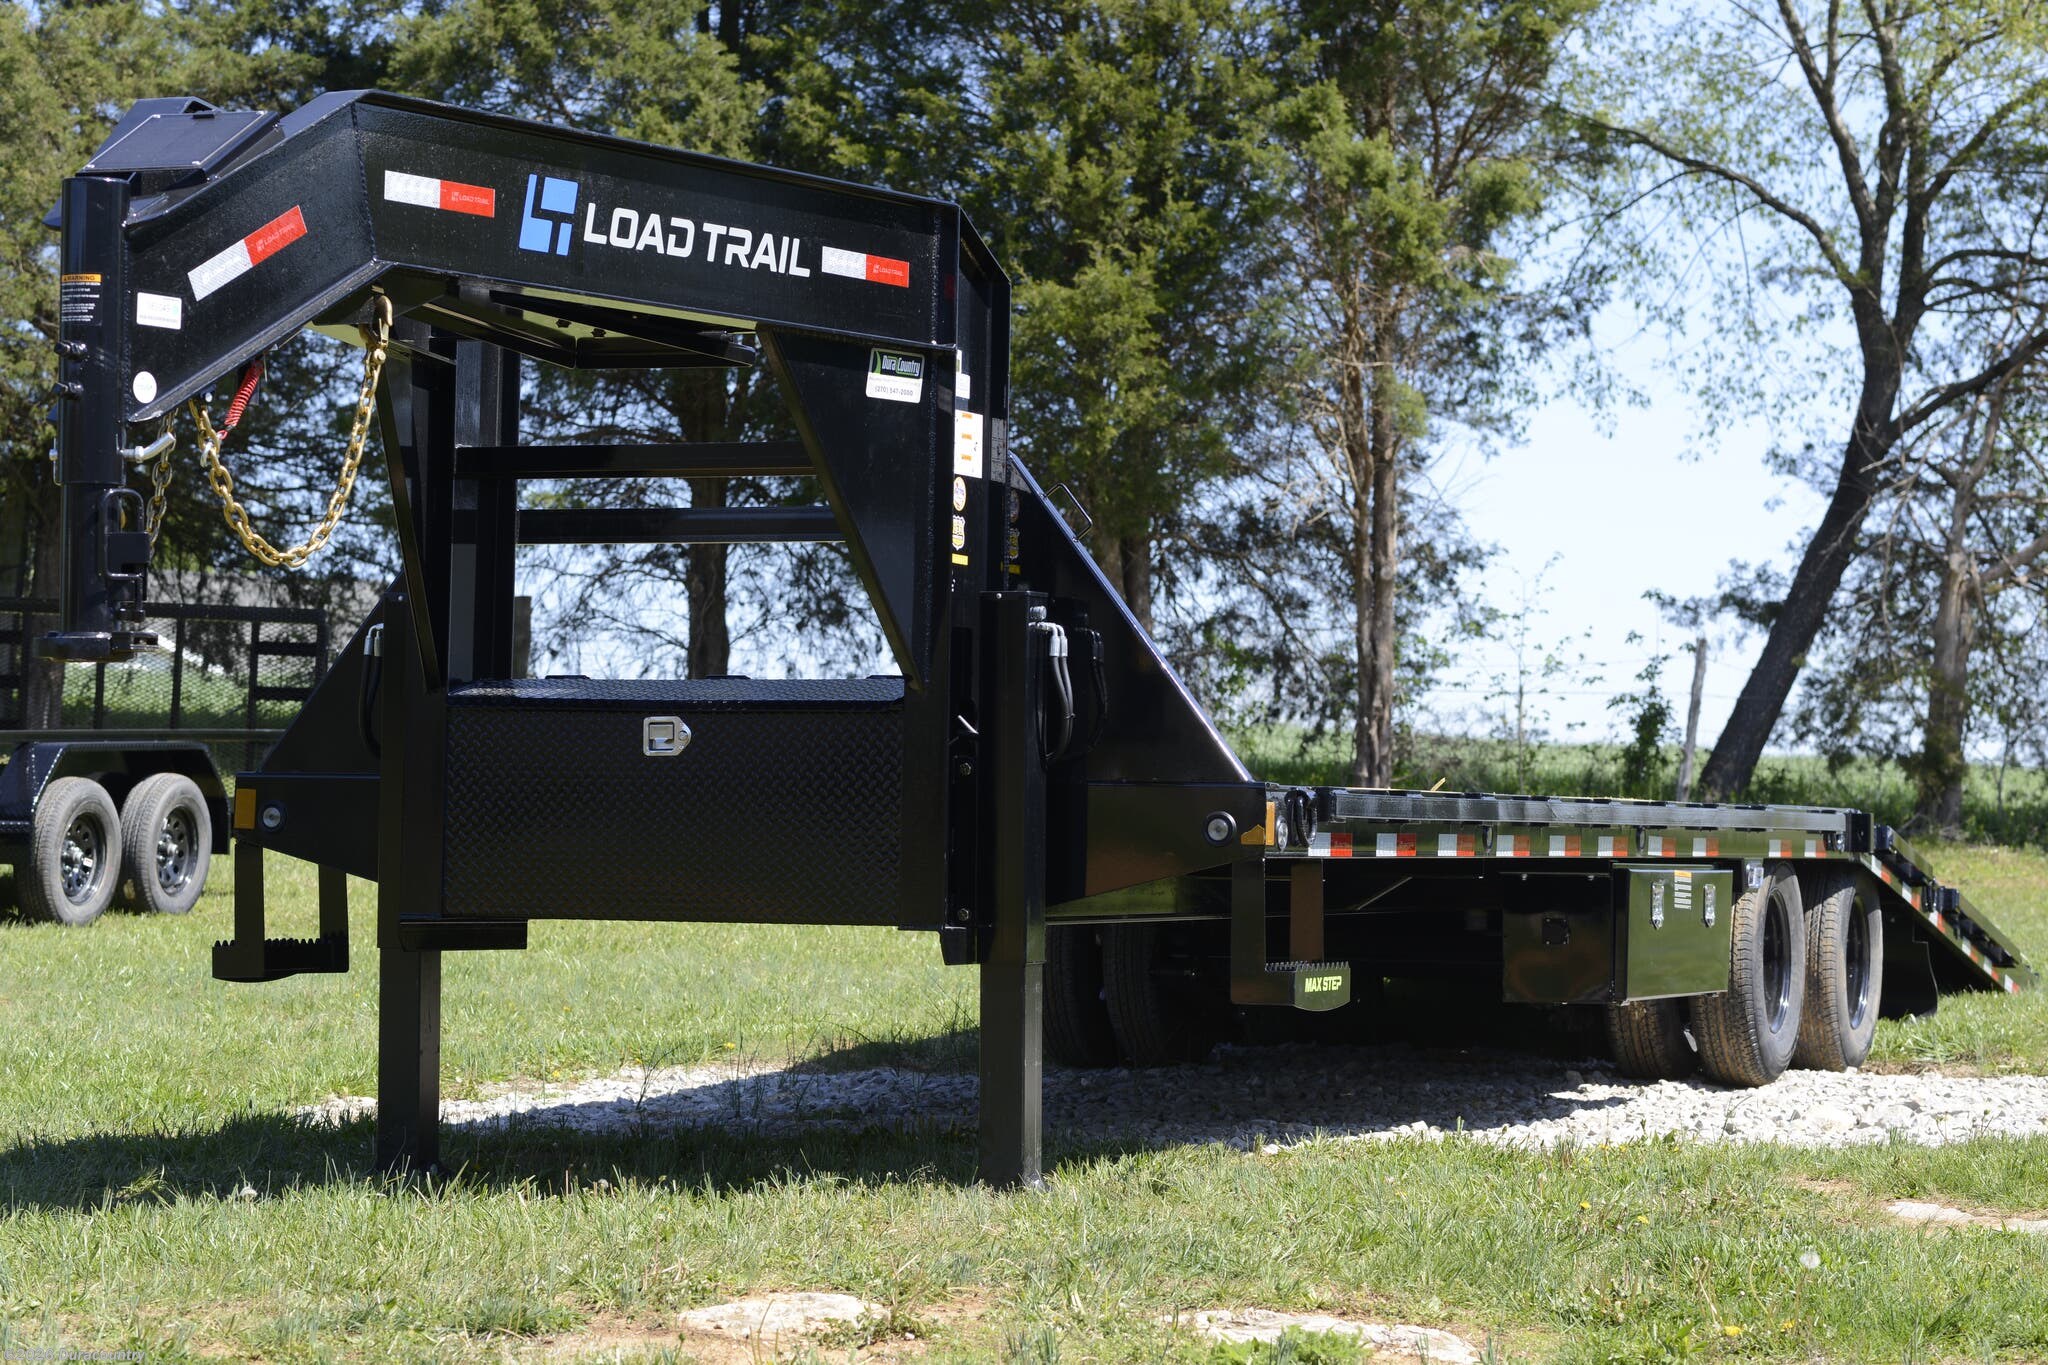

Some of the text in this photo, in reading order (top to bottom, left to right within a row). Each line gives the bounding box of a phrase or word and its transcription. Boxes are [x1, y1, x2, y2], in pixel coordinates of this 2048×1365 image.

[584, 202, 811, 278] LOAD TRAIL
[882, 355, 920, 376] Dura Country
[1305, 976, 1342, 992] MAX STEP
